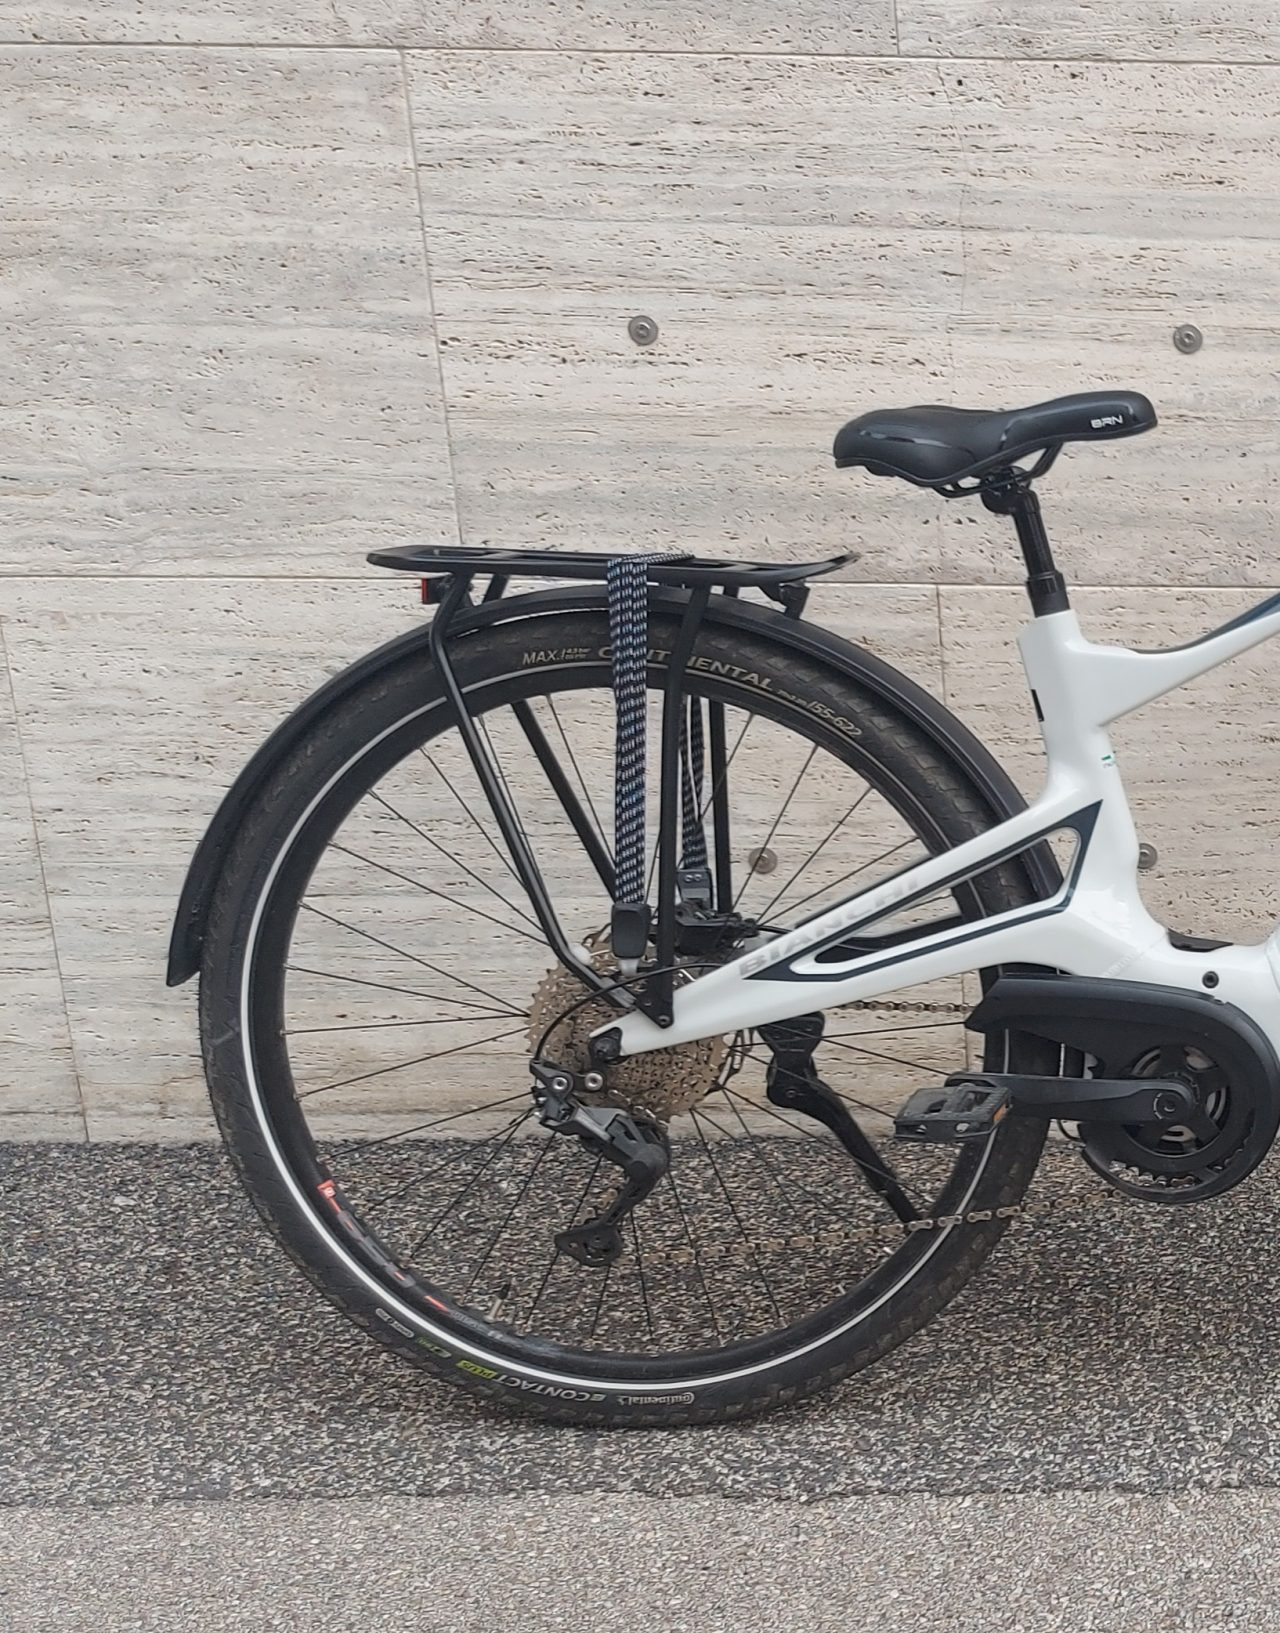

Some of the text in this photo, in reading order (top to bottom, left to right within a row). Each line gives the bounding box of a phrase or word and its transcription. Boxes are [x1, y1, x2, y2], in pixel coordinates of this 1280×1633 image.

[1090, 414, 1124, 429] BRN
[739, 878, 919, 975] BIANCHI
[459, 1361, 496, 1379] PLUS
[630, 1391, 696, 1406] Continental
